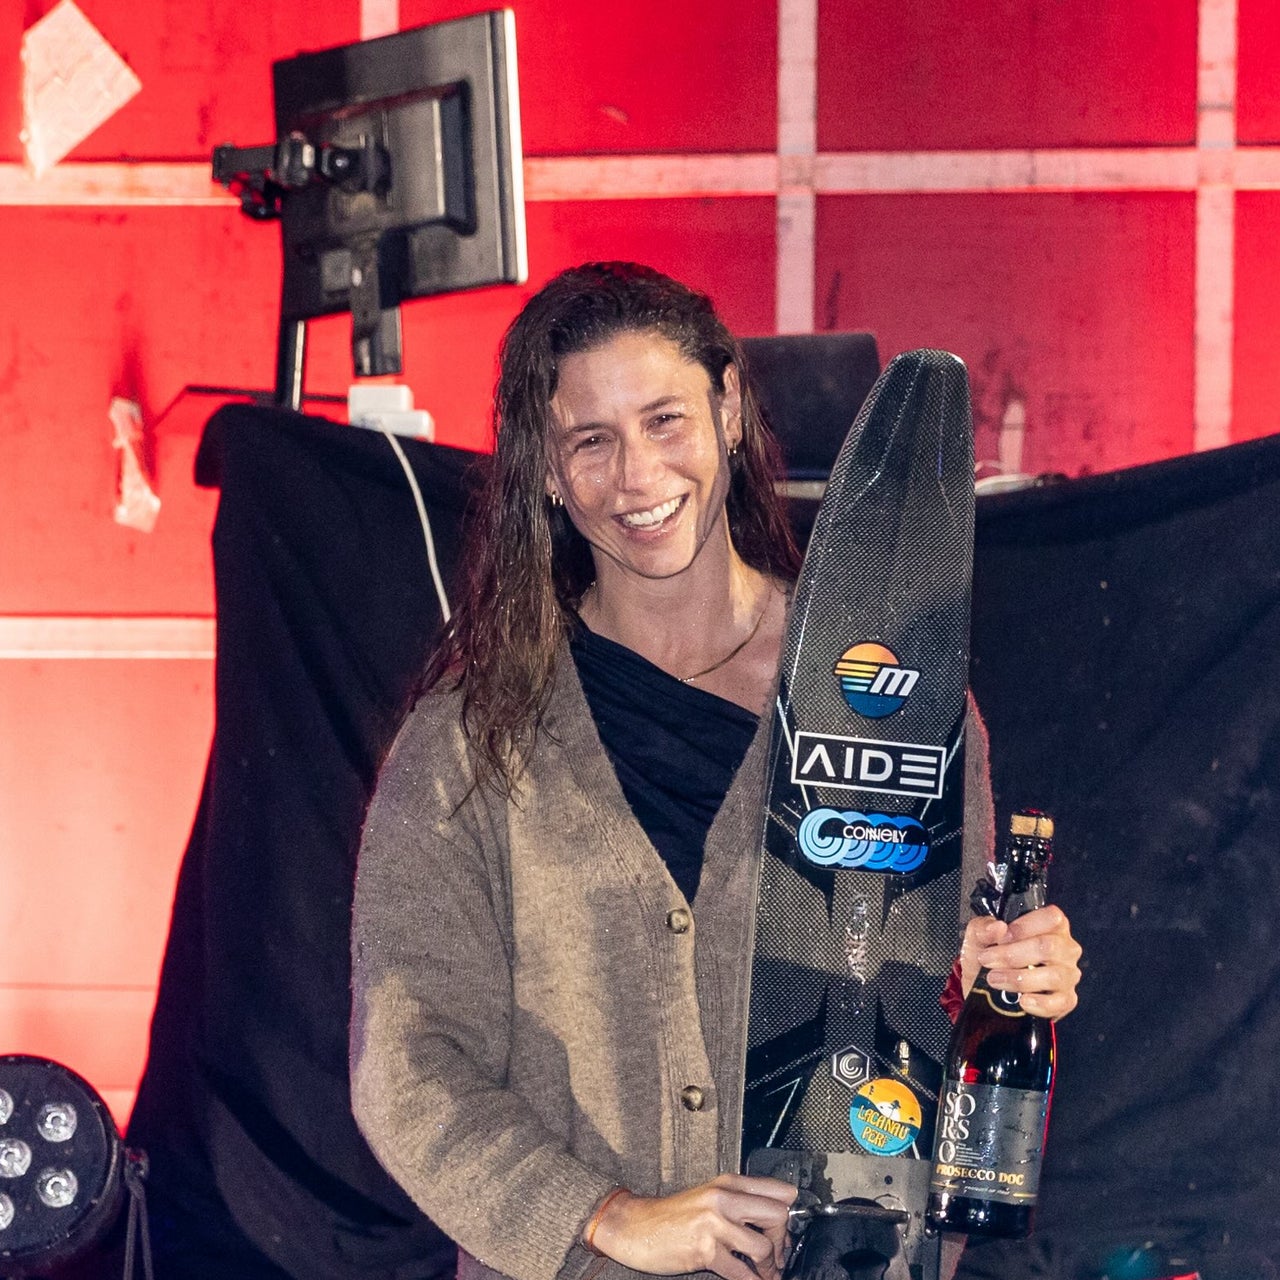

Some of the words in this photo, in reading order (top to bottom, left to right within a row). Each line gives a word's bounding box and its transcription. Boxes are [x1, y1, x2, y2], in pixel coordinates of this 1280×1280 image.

[800, 743, 938, 788] AIDE
[944, 1090, 976, 1117] SO
[857, 1105, 910, 1140] LACANAU
[941, 1115, 970, 1141] RS
[938, 1140, 956, 1163] O
[936, 1163, 996, 1181] PROSECCO
[998, 1172, 1025, 1186] DOC
